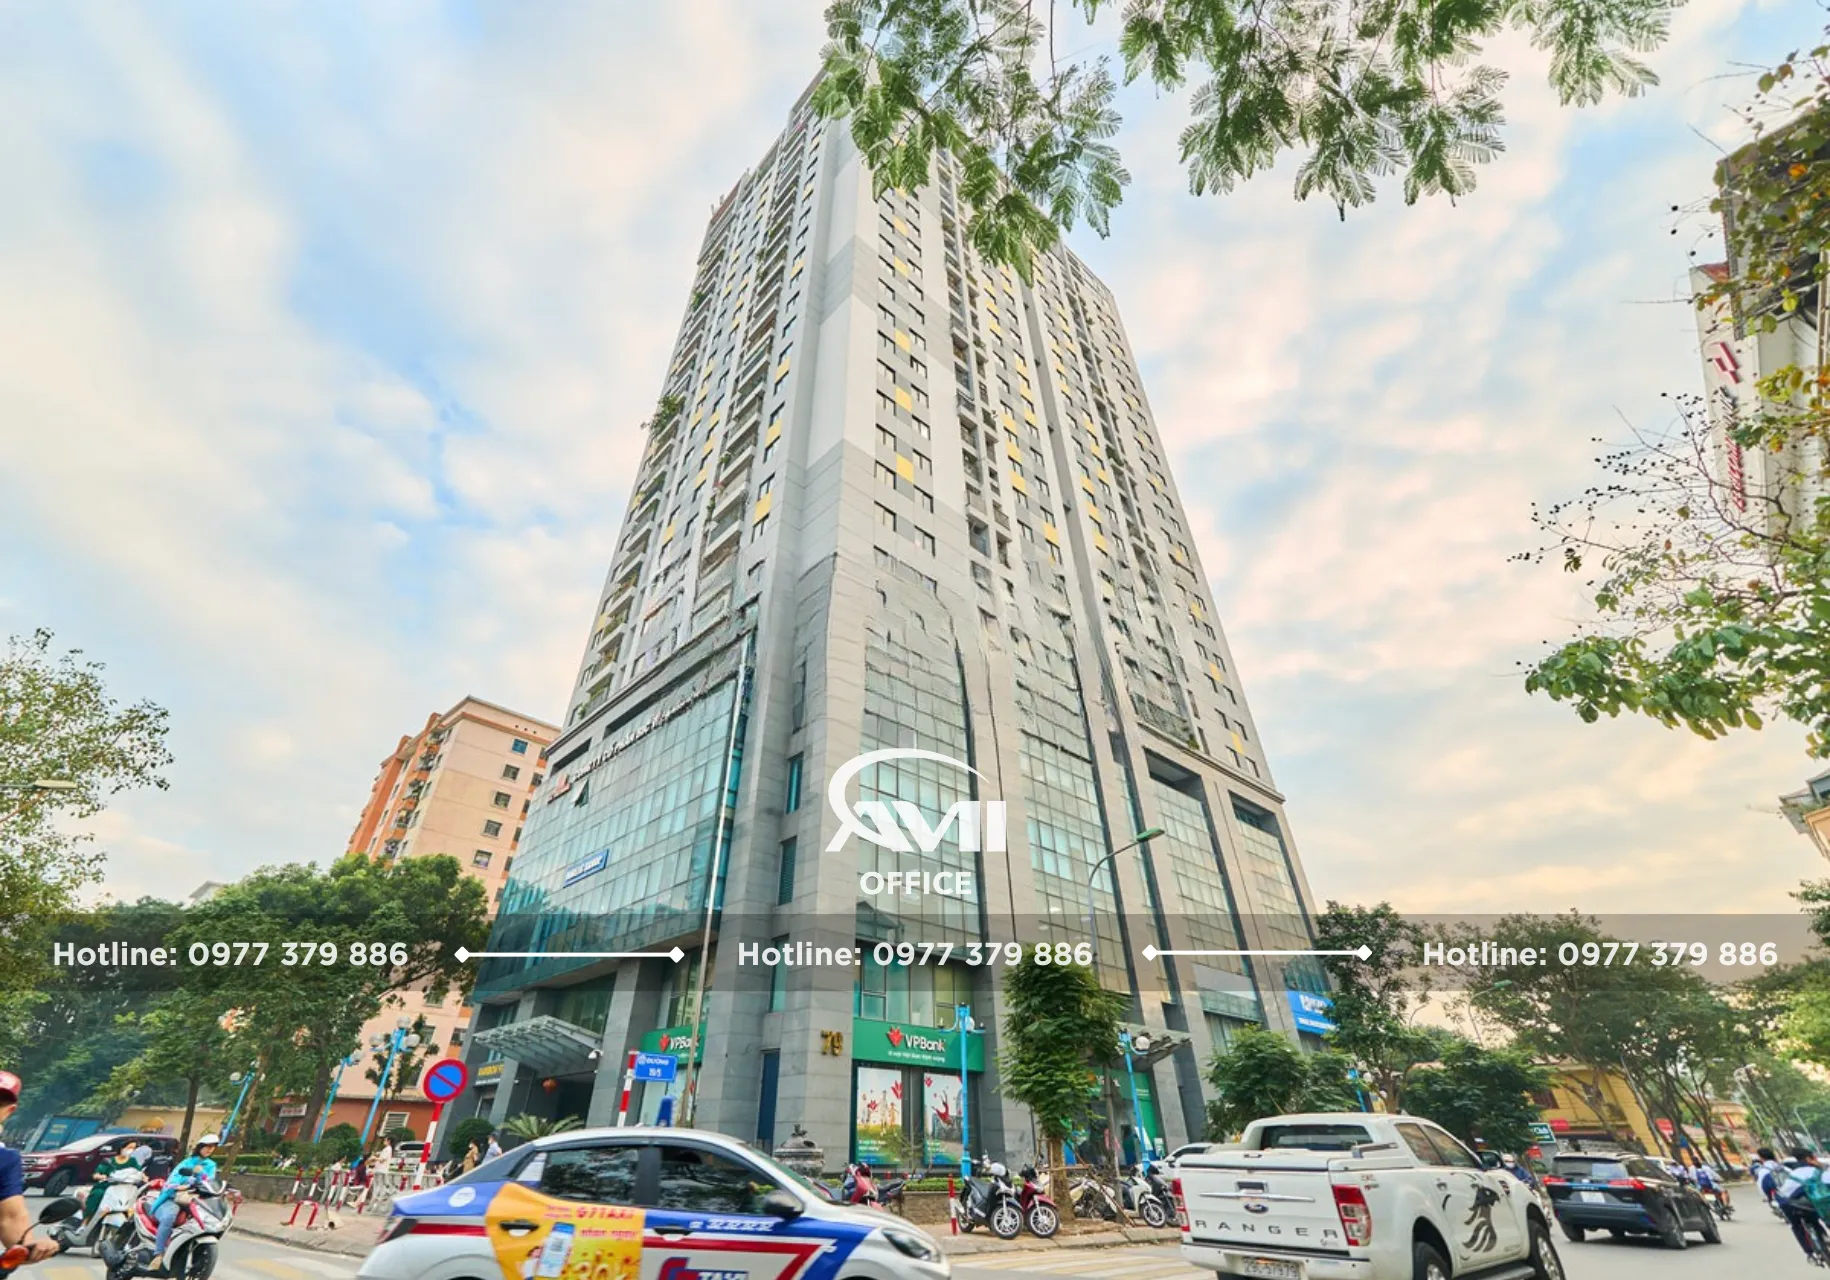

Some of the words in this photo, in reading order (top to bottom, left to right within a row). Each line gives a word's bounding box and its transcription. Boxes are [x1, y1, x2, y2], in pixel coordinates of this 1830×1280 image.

[821, 1029, 843, 1056] 79
[905, 1034, 946, 1052] VPBank
[1195, 1219, 1338, 1239] RANGER
